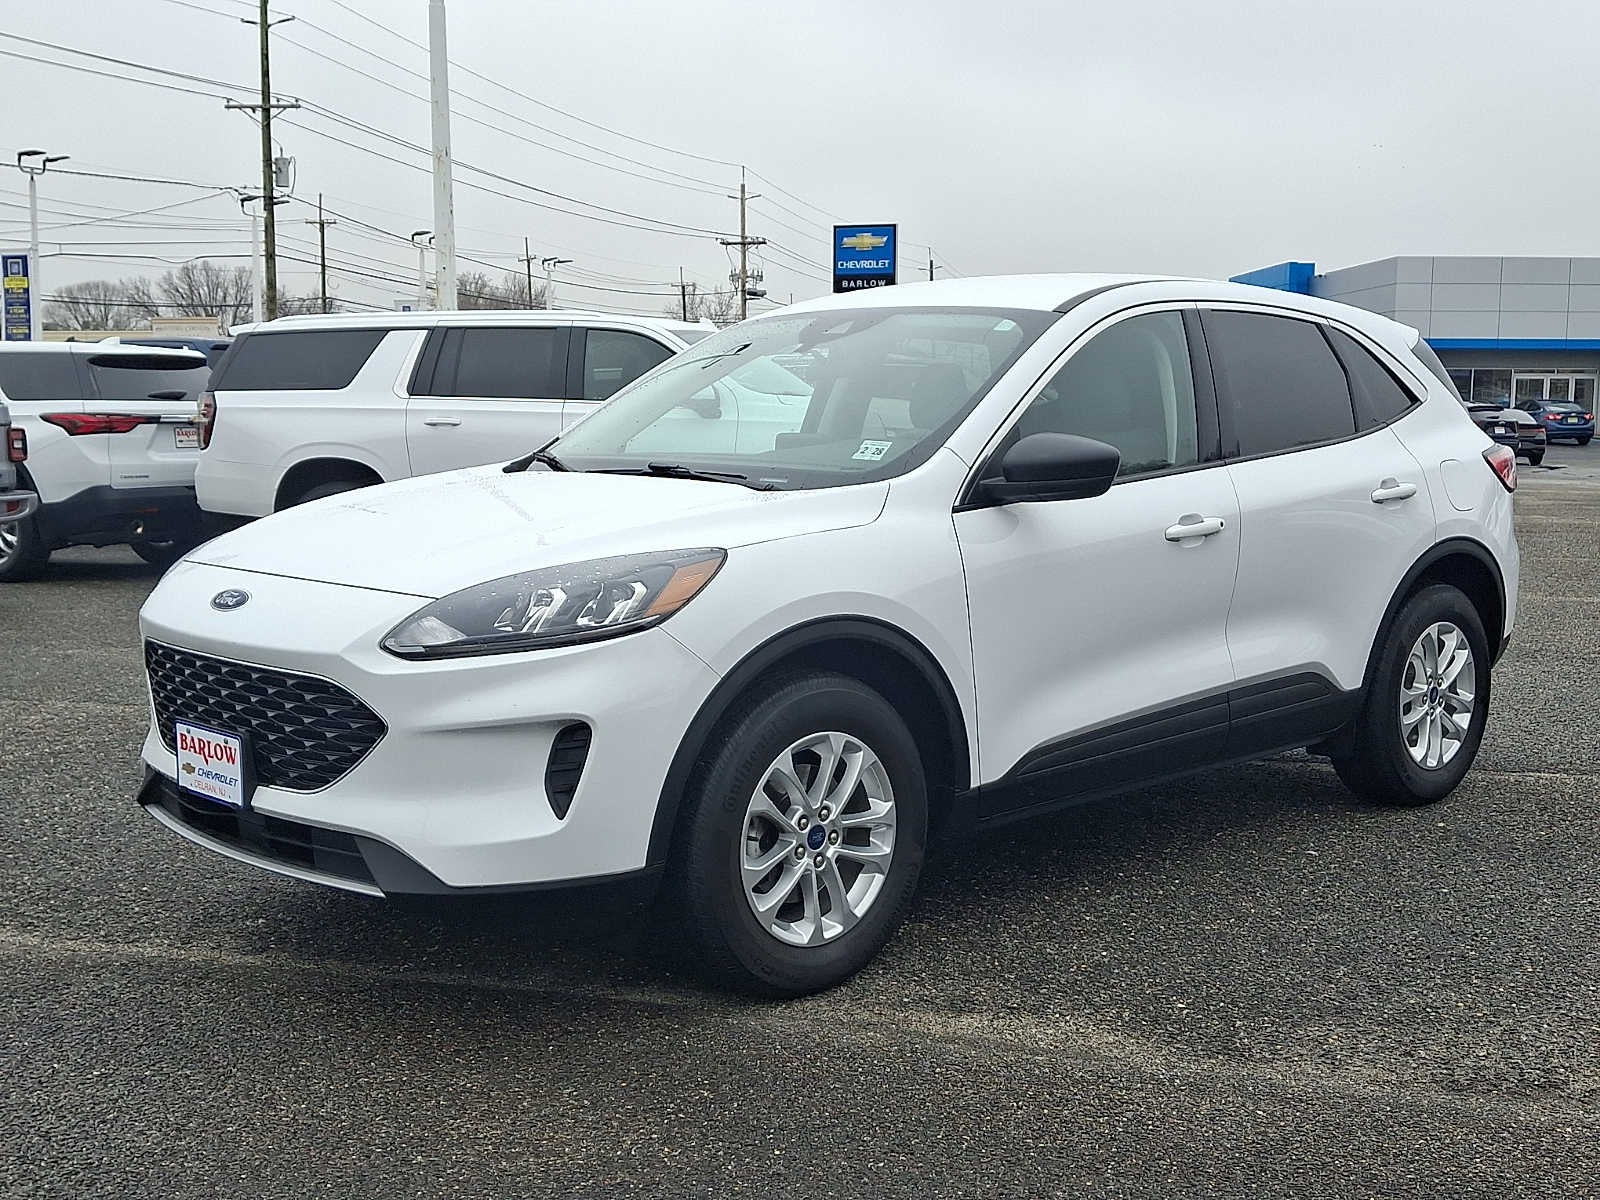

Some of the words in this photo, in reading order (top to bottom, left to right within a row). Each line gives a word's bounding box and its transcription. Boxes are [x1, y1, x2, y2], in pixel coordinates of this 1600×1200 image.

[838, 260, 890, 269] CHEVROLET
[842, 279, 886, 288] BARLOW
[176, 430, 197, 438] BARLO
[871, 447, 885, 456] 28
[215, 591, 242, 606] Ford
[179, 732, 237, 766] BARLOW
[197, 767, 239, 788] CHEVROLET
